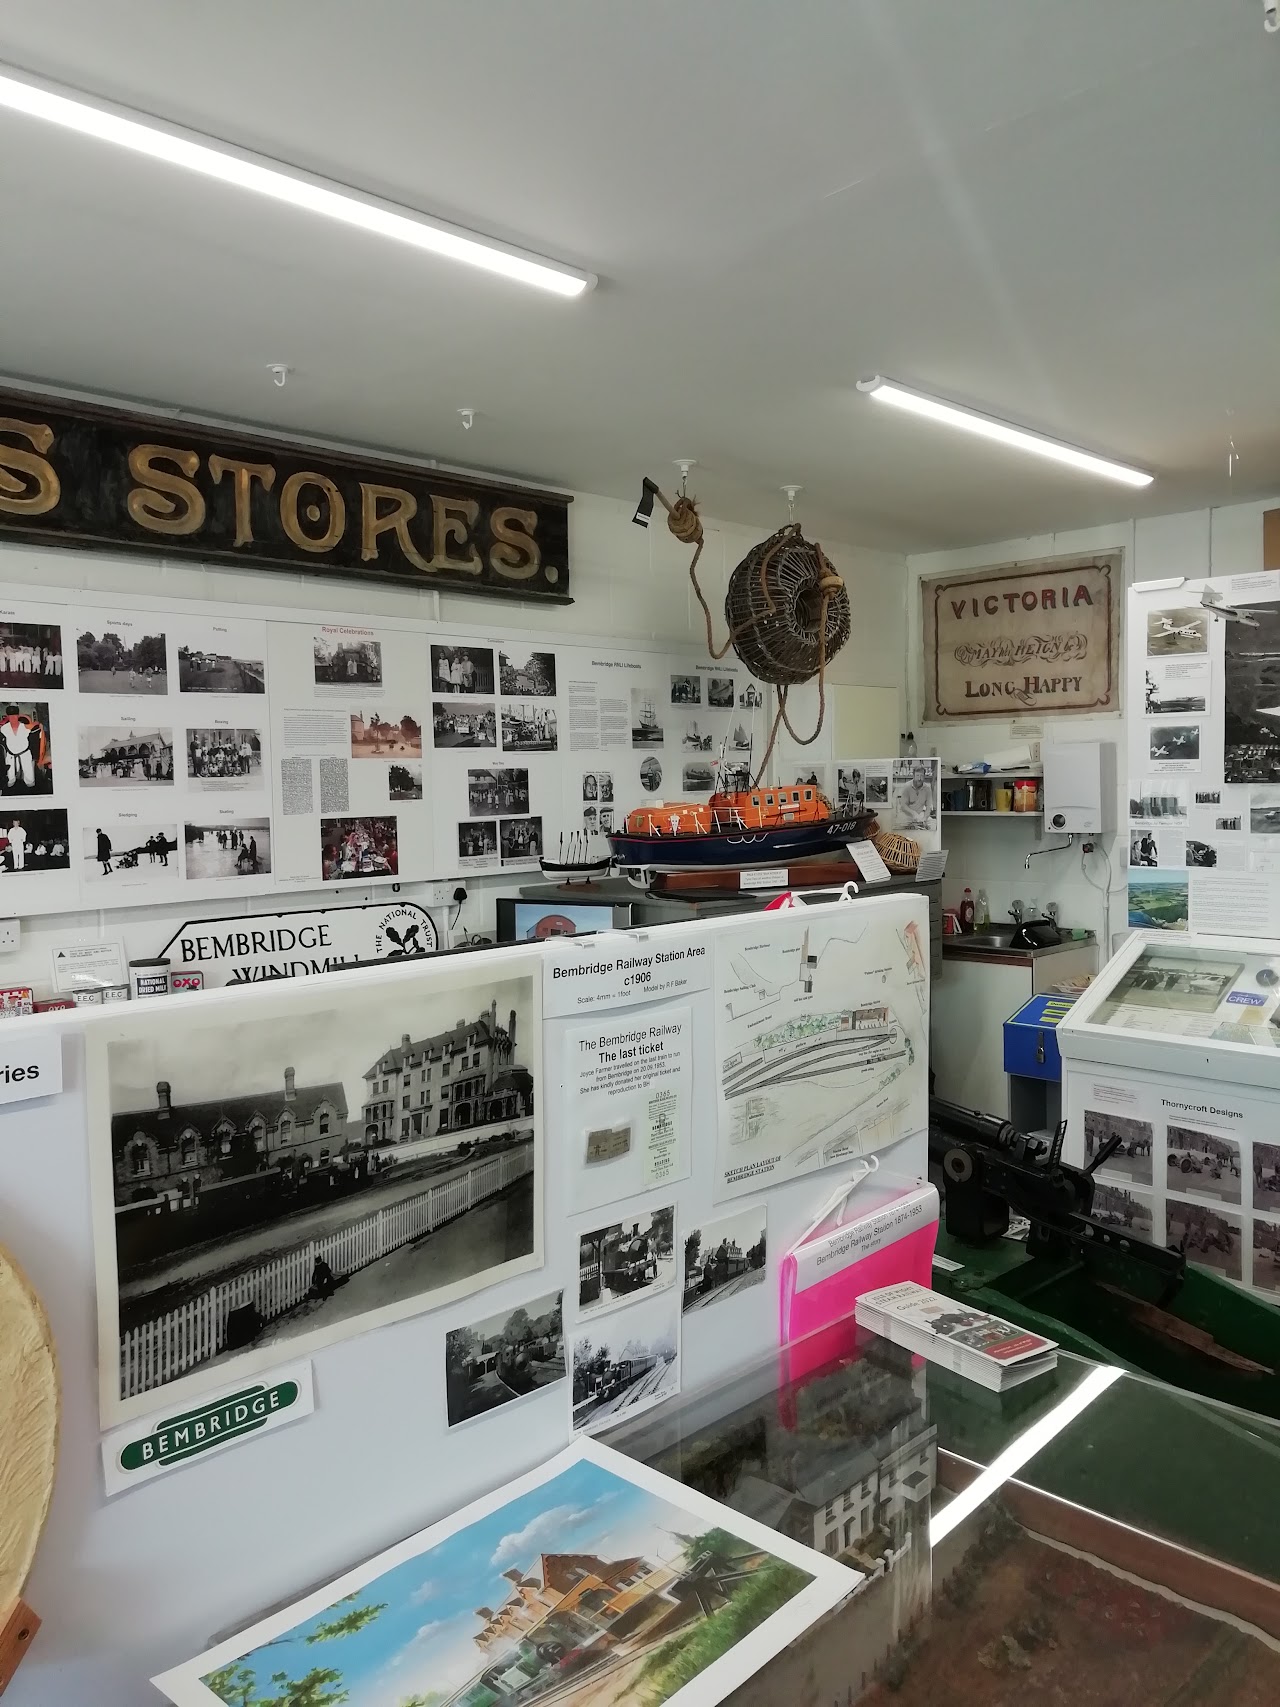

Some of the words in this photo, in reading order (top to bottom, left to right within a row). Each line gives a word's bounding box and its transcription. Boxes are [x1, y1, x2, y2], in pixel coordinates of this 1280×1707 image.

[127, 443, 559, 584] STORES.
[951, 585, 1093, 619] VICTORIA
[322, 626, 338, 634] Royal
[340, 628, 374, 636] Celebrations
[1024, 676, 1082, 694] HAPPY
[827, 821, 857, 835] 47-018
[378, 909, 416, 930] NATIONAL
[420, 918, 432, 948] TRUST
[180, 924, 332, 962] BEMBRIDGE
[553, 963, 613, 978] Bembridge
[616, 956, 653, 970] Railway
[655, 951, 685, 964] Station
[686, 946, 705, 958] Area
[140, 978, 166, 986] NATIONAL
[624, 972, 651, 986] c1906
[643, 985, 658, 993] Model
[675, 979, 687, 987] Baker
[577, 996, 595, 1004] Scale:
[618, 990, 631, 998] 1foot
[1228, 996, 1261, 1004] CREW
[579, 1040, 597, 1051] The
[600, 1030, 647, 1048] Bembridge
[649, 1024, 682, 1037] Railway
[599, 1052, 617, 1063] The
[620, 1046, 636, 1059] last
[639, 1041, 664, 1055] ticket
[580, 1070, 594, 1078] Joyce
[596, 1066, 612, 1074] Farmer
[613, 1061, 633, 1070] travelled
[608, 1070, 632, 1079] Bembridge
[601, 1080, 614, 1089] kindly
[615, 1077, 633, 1086] donated
[643, 1071, 659, 1080] original
[608, 1085, 637, 1096] reproduction
[1161, 1099, 1207, 1113] Thornycroft
[1210, 1106, 1243, 1118] Designs
[724, 1166, 743, 1178] SKETCH
[744, 1163, 756, 1172] PLAN
[756, 1157, 775, 1168] LAYOUT
[727, 1170, 754, 1184] BEMBRIDGE
[755, 1165, 774, 1176] STATION
[816, 1244, 849, 1266] Bembridge
[850, 1232, 872, 1248] Railway
[874, 1221, 893, 1236] Station
[894, 1204, 922, 1224] 1874-1953
[870, 1238, 881, 1247] story
[897, 1302, 918, 1310] Guide
[142, 1391, 280, 1460] BEMBRIDGE
